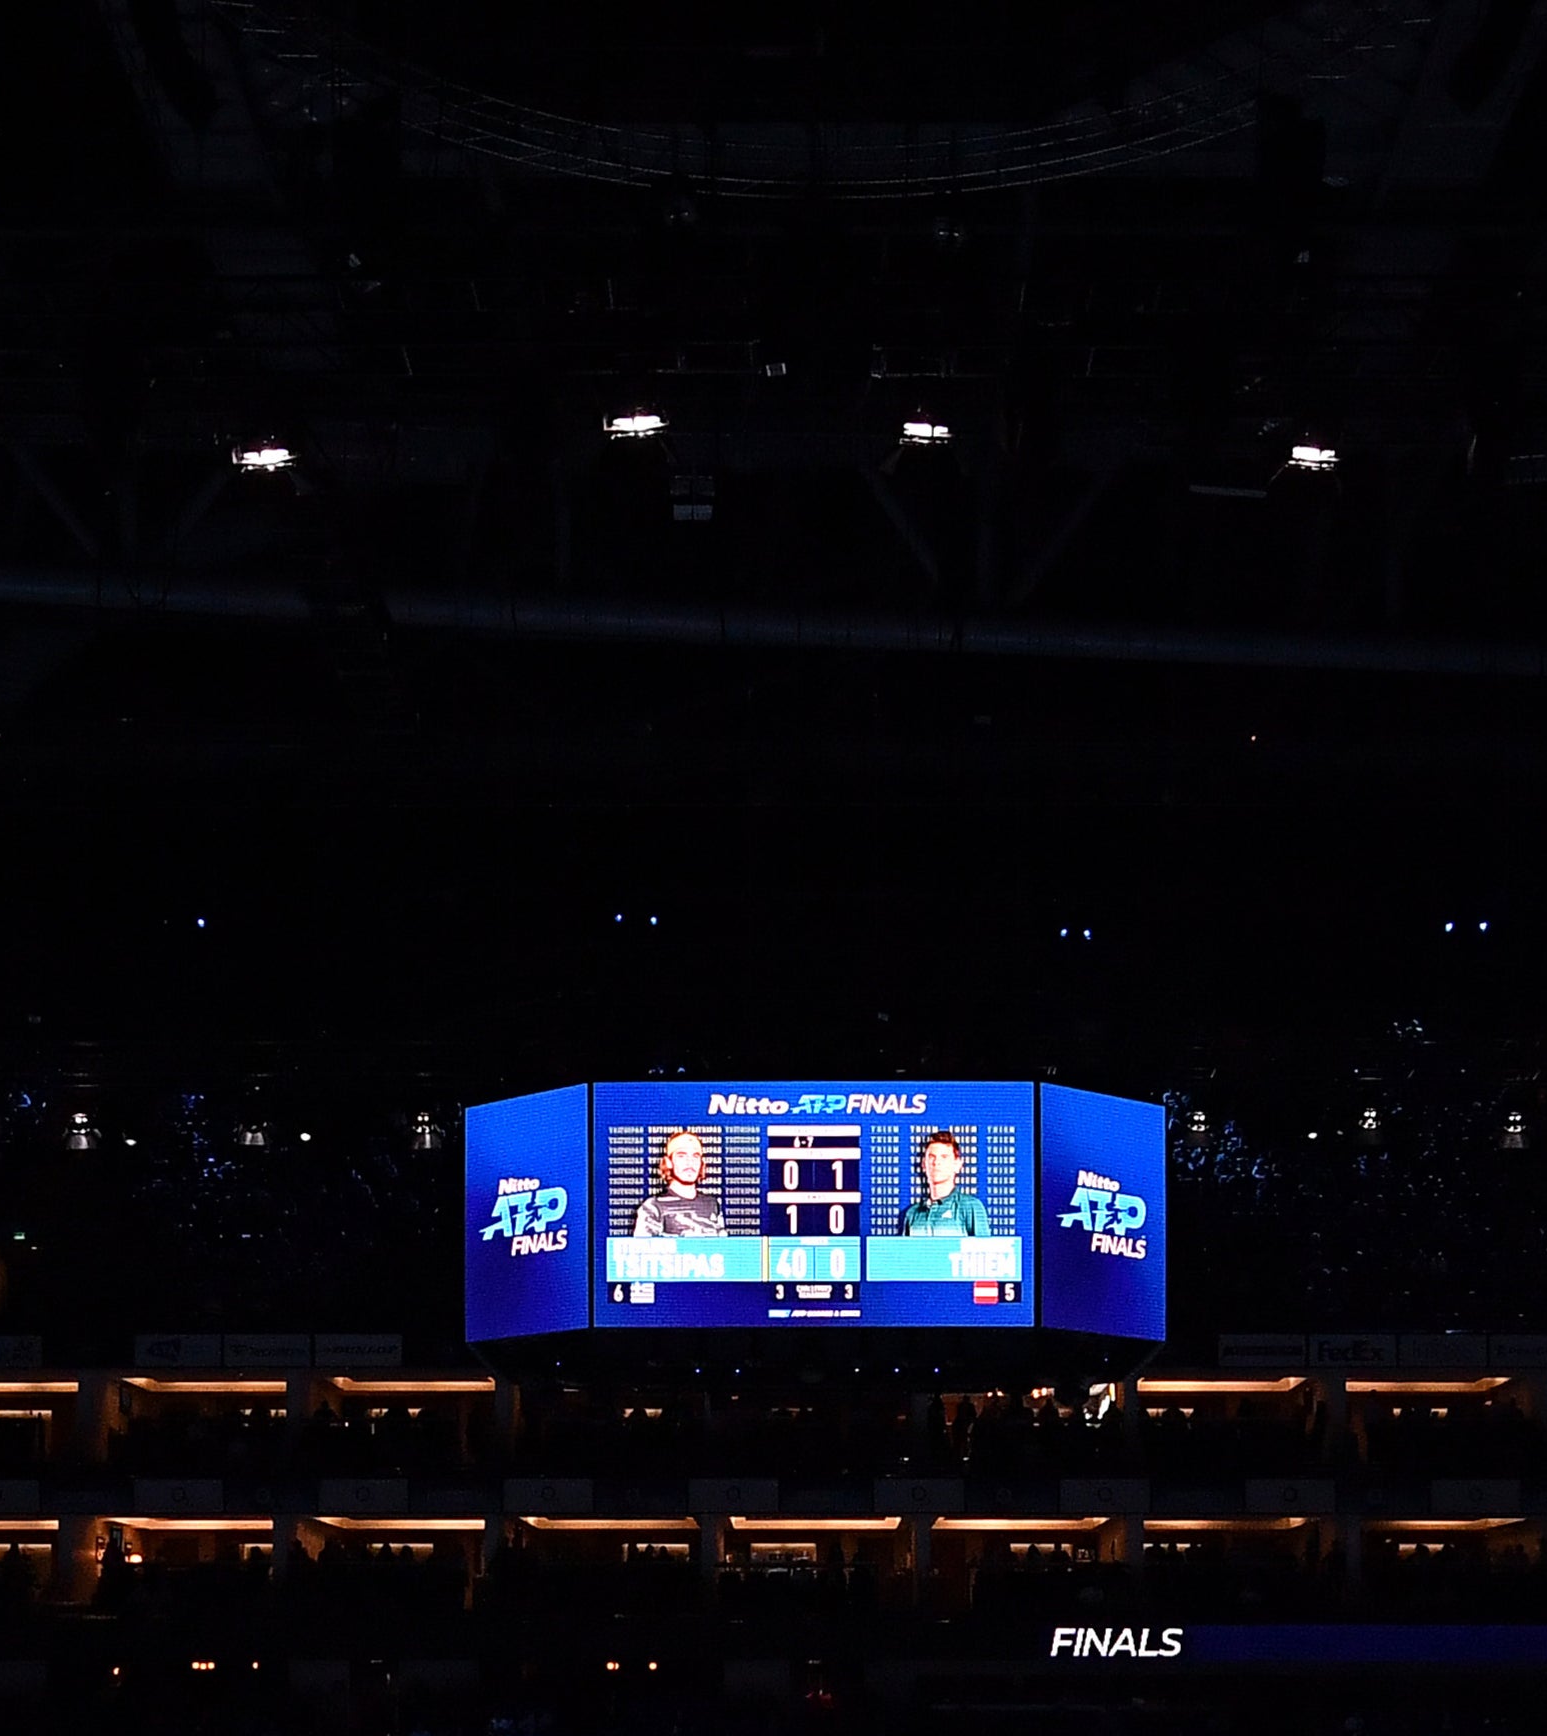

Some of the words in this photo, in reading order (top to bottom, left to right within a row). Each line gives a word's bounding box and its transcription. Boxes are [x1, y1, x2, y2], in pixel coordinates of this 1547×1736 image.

[709, 1094, 789, 1114] Nitto
[790, 1094, 846, 1114] ATP
[847, 1094, 927, 1114] FINALS
[498, 1177, 540, 1195] Nitto
[783, 1160, 799, 1190] 0
[831, 1160, 843, 1190] 1
[1077, 1169, 1120, 1192] Nitto
[478, 1187, 568, 1241] ATP
[786, 1204, 798, 1235] 1
[829, 1204, 845, 1235] 0
[1056, 1187, 1146, 1236] ATP
[511, 1230, 568, 1257] FINALS
[1091, 1232, 1147, 1260] FINALS
[776, 1248, 807, 1278] 40
[830, 1248, 846, 1278] 0
[613, 1284, 624, 1300] 6
[775, 1284, 784, 1299] 3
[844, 1284, 853, 1299] 3
[1004, 1283, 1015, 1301] 5
[1050, 1627, 1183, 1657] FINALS
